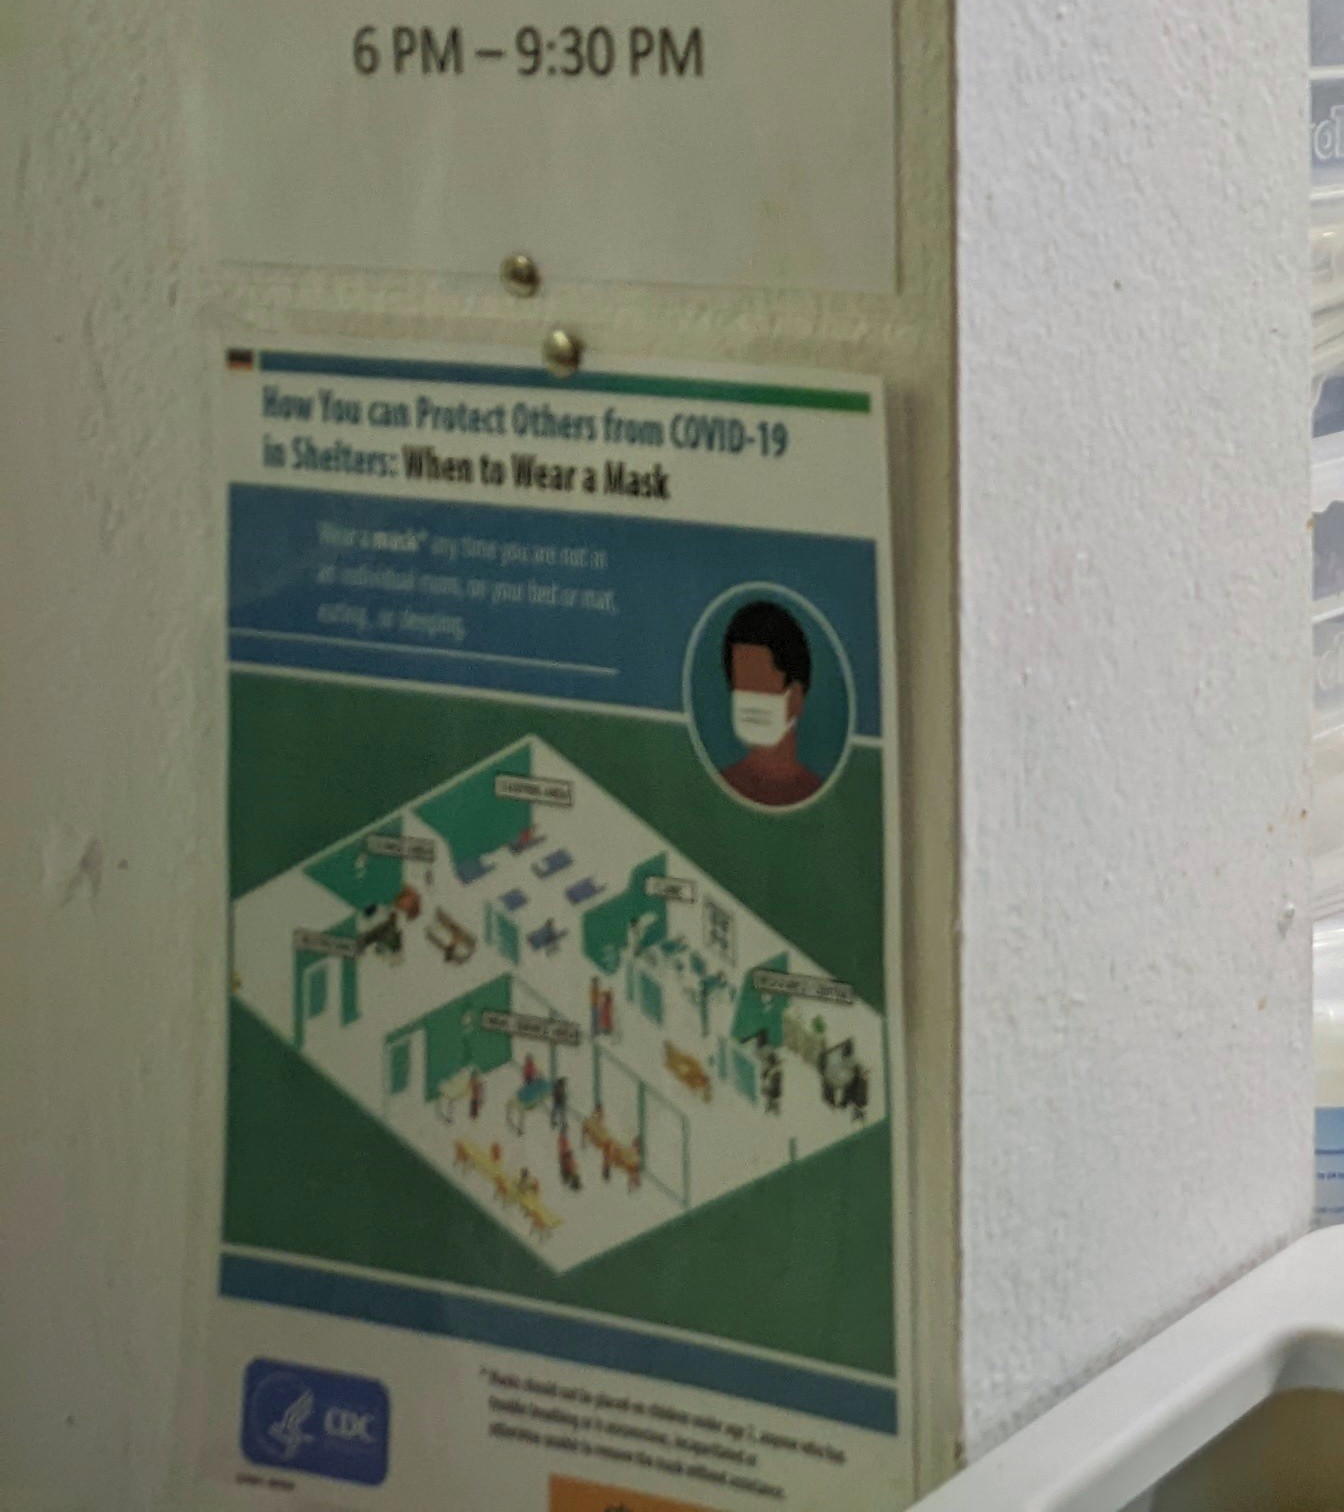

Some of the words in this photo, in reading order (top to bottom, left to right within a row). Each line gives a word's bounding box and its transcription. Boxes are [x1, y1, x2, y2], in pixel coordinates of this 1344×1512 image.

[353, 25, 380, 76] 6
[392, 26, 464, 75] PM
[515, 25, 615, 78] 9:30
[629, 26, 704, 77] PM
[263, 385, 312, 421] How
[319, 388, 361, 425] You
[367, 400, 409, 428] can
[416, 394, 506, 436] Protect
[511, 402, 598, 439] Others
[603, 407, 664, 447] from
[669, 413, 789, 458] COVID-19
[263, 432, 286, 469] in
[291, 436, 398, 478] Shelters:
[401, 443, 474, 484] When
[480, 454, 506, 486] to
[511, 453, 577, 492] Wear
[582, 465, 597, 494] a
[603, 460, 670, 501] Mask
[323, 1406, 376, 1444] CDC
